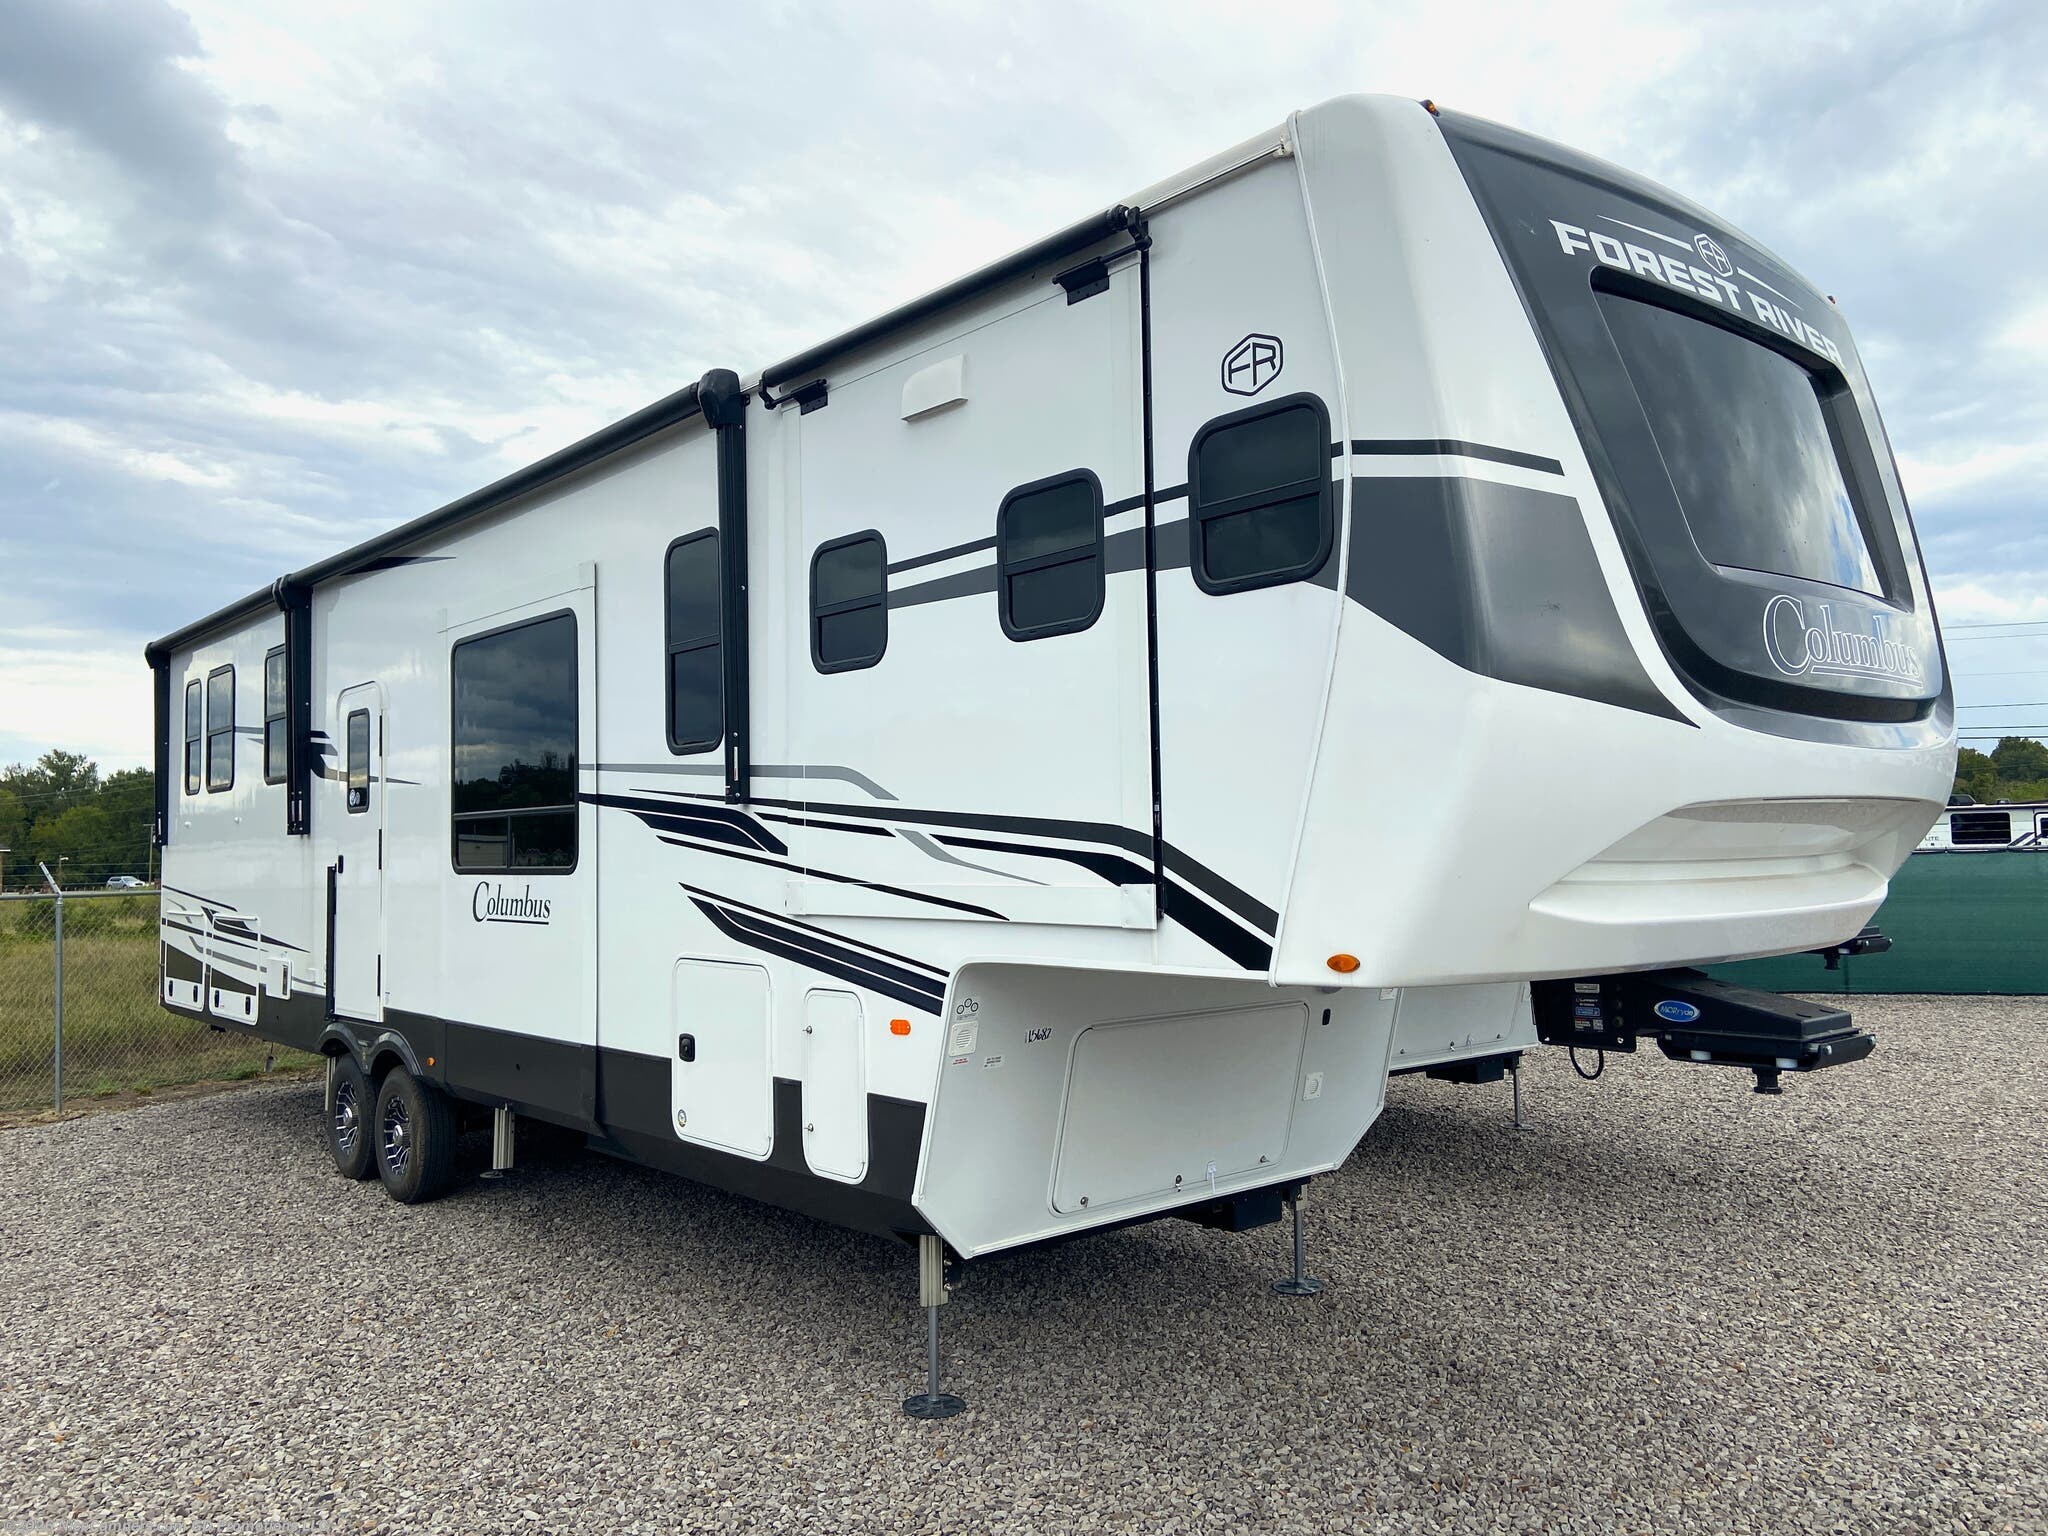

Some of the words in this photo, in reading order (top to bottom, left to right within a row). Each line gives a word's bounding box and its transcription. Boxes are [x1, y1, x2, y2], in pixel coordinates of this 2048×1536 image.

[1549, 219, 1743, 311] FOREST
[1749, 290, 1845, 367] RIVER
[1762, 594, 1922, 678] Columbus
[472, 881, 551, 922] Columbus
